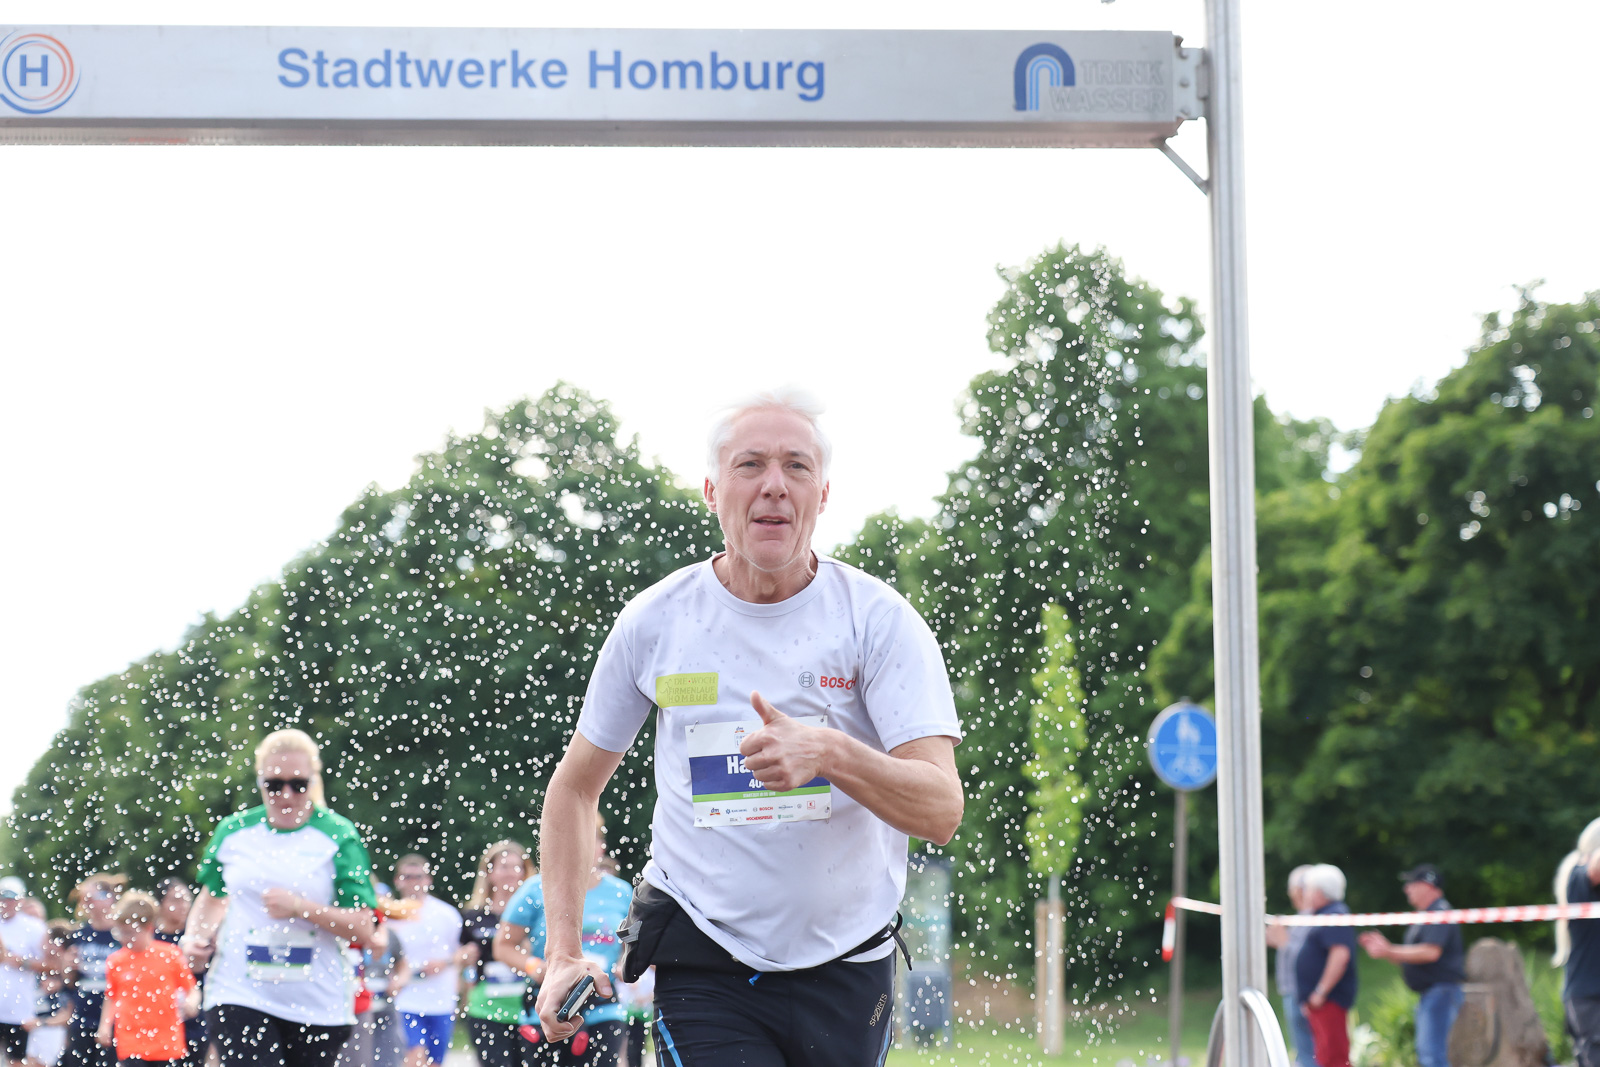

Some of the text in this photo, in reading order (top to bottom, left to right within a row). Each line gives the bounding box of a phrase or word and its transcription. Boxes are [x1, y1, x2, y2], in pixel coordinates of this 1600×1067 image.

[278, 48, 825, 102] Stadtwerke Homburg
[1080, 59, 1163, 85] TRINK
[1052, 87, 1167, 113] WASSER
[668, 686, 715, 694] FIRMENLAUF
[668, 694, 715, 703] HOMBURG
[726, 755, 754, 774] Ha
[749, 779, 764, 788] 40
